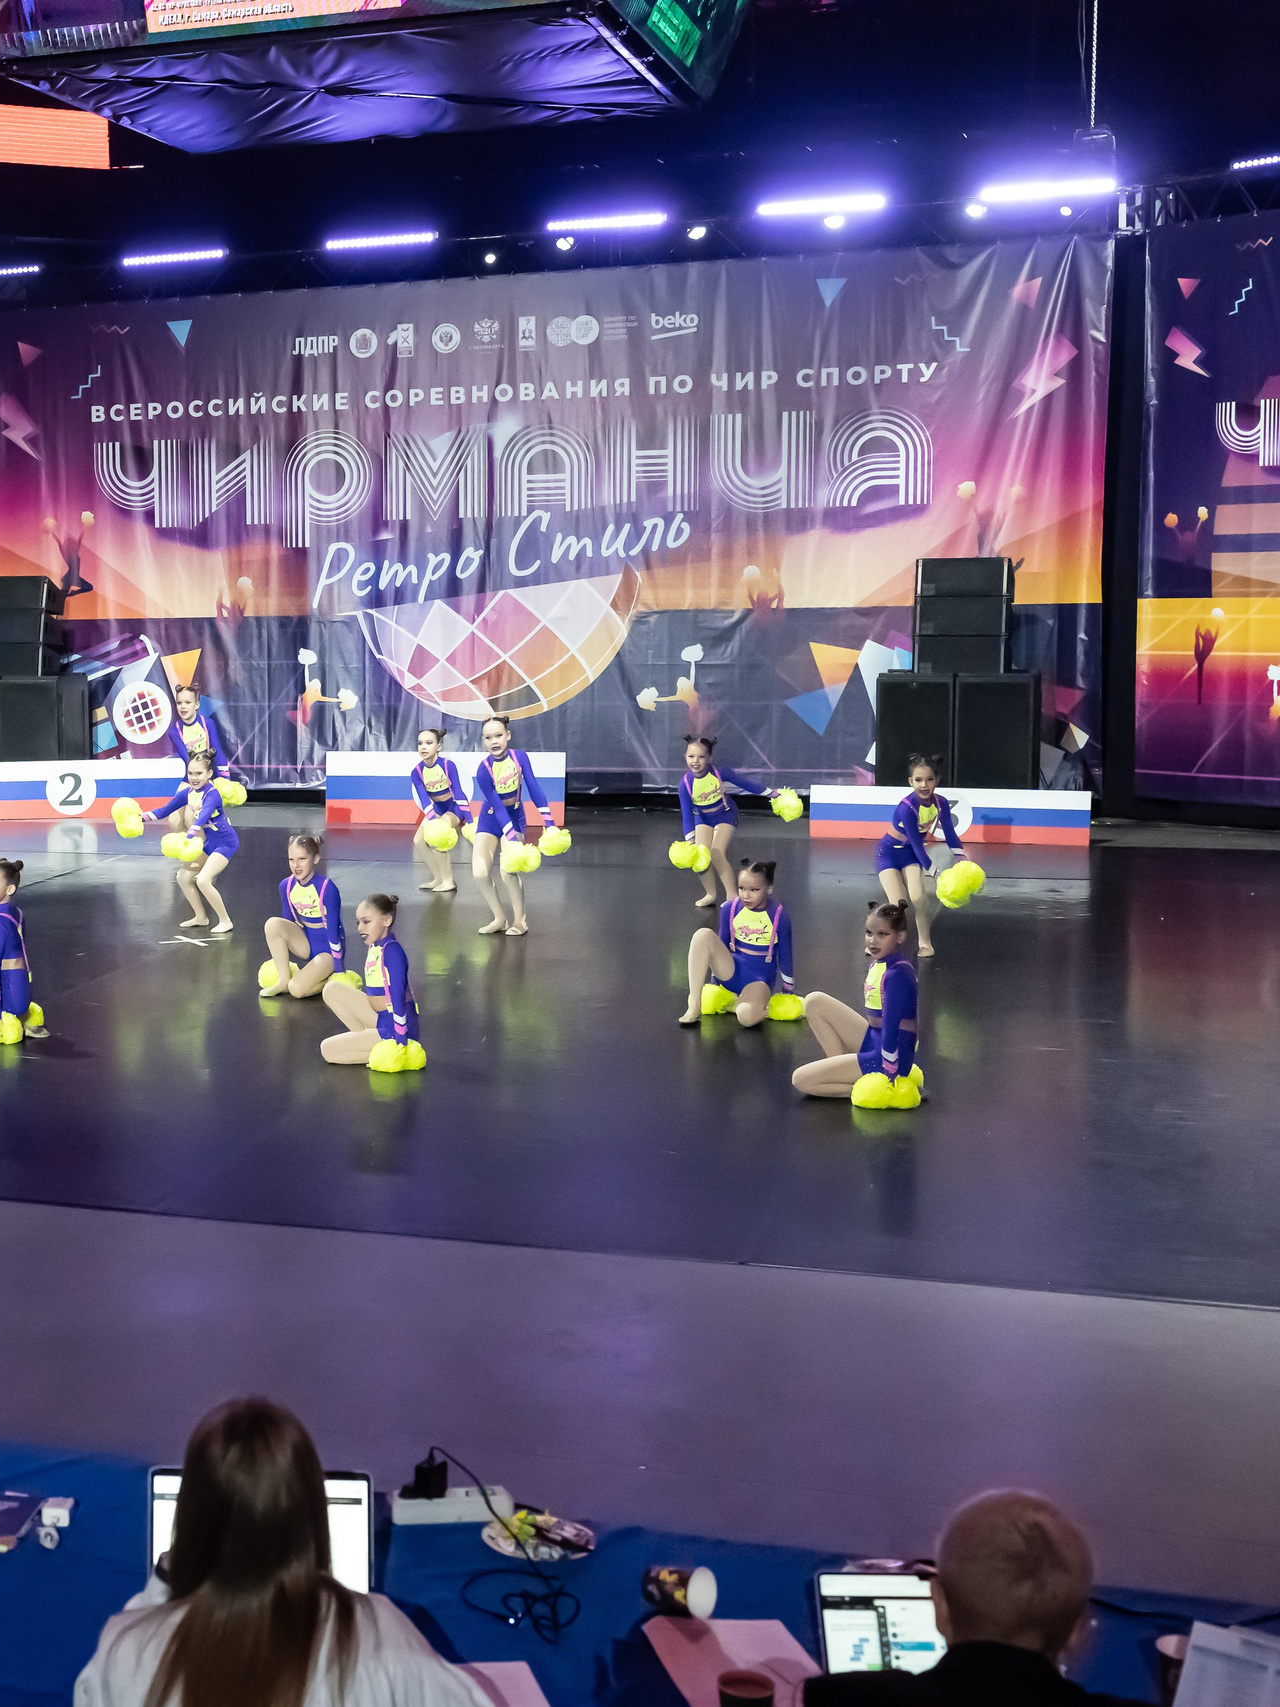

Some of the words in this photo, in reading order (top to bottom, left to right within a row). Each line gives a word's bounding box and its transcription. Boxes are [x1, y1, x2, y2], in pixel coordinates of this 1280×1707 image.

[651, 312, 699, 329] beko
[293, 336, 338, 357] ЛДПР
[91, 391, 349, 423] ВСЕРОССИЙСКИЕ
[365, 378, 630, 409] СОРЕВНОВАНИЯ
[649, 374, 694, 395] ПО
[711, 370, 779, 393] ЧИР
[797, 362, 939, 388] СПОРТУ
[312, 541, 485, 609] Ретро
[508, 509, 692, 577] Стиль
[59, 773, 83, 806] 2
